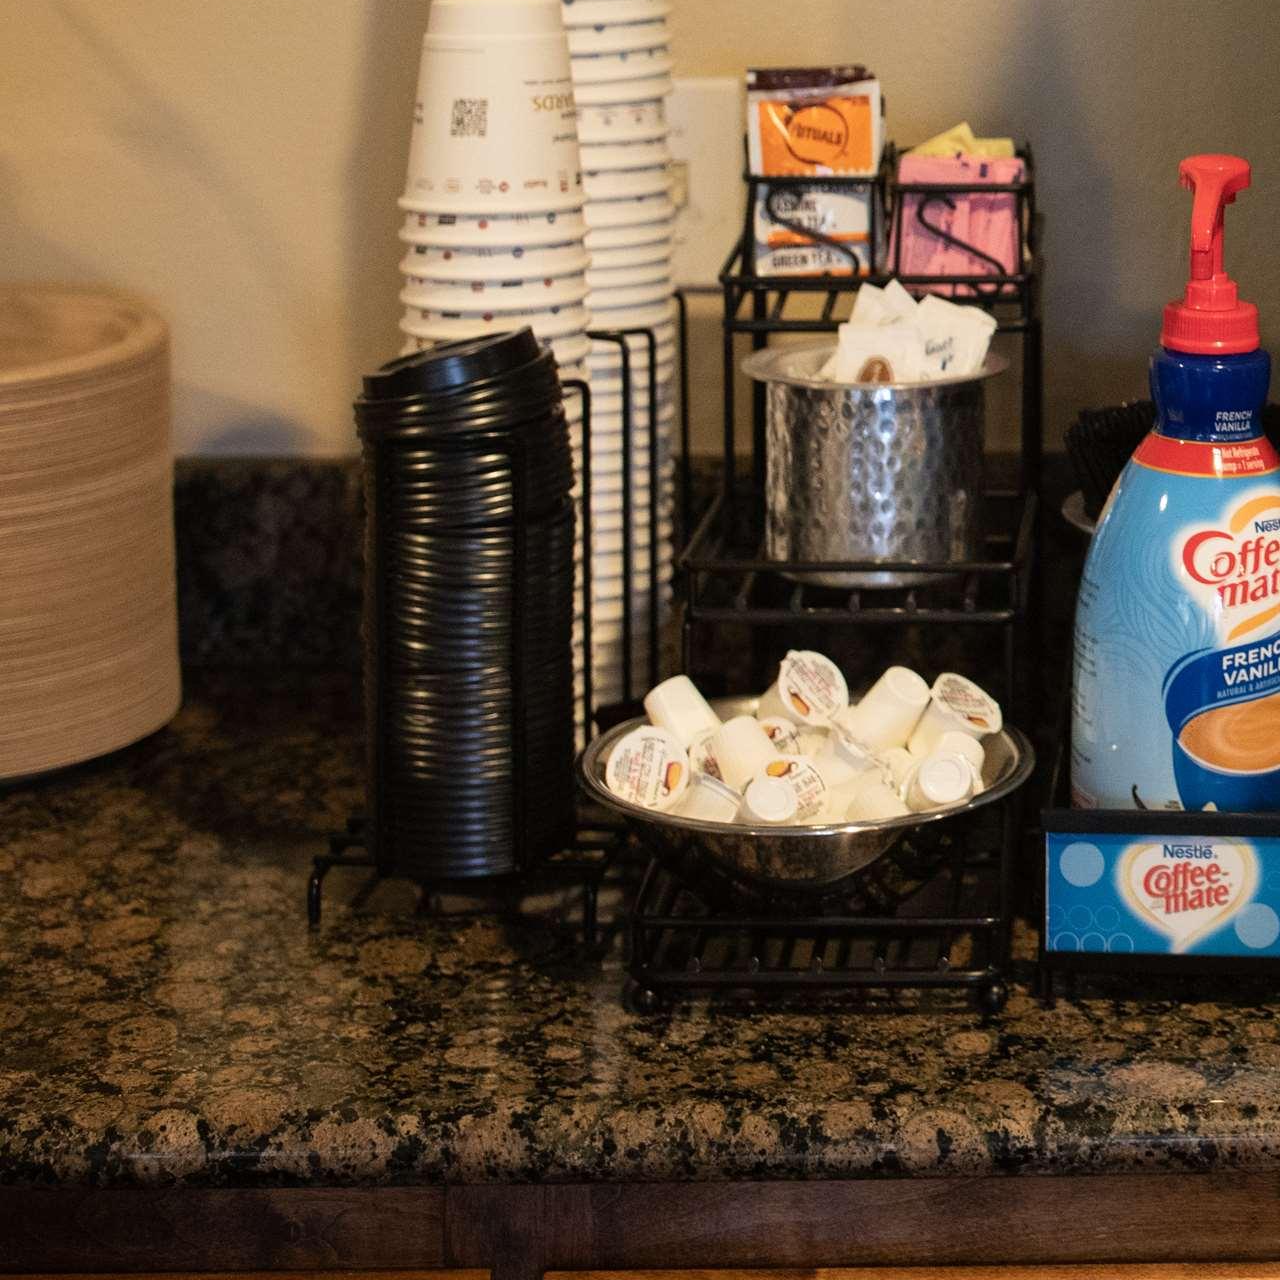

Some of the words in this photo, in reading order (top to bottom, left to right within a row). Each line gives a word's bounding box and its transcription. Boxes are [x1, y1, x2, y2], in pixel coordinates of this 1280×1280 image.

[1216, 409, 1253, 421] FRENCH
[1214, 420, 1251, 432] VANILLA
[1163, 884, 1230, 914] mate
